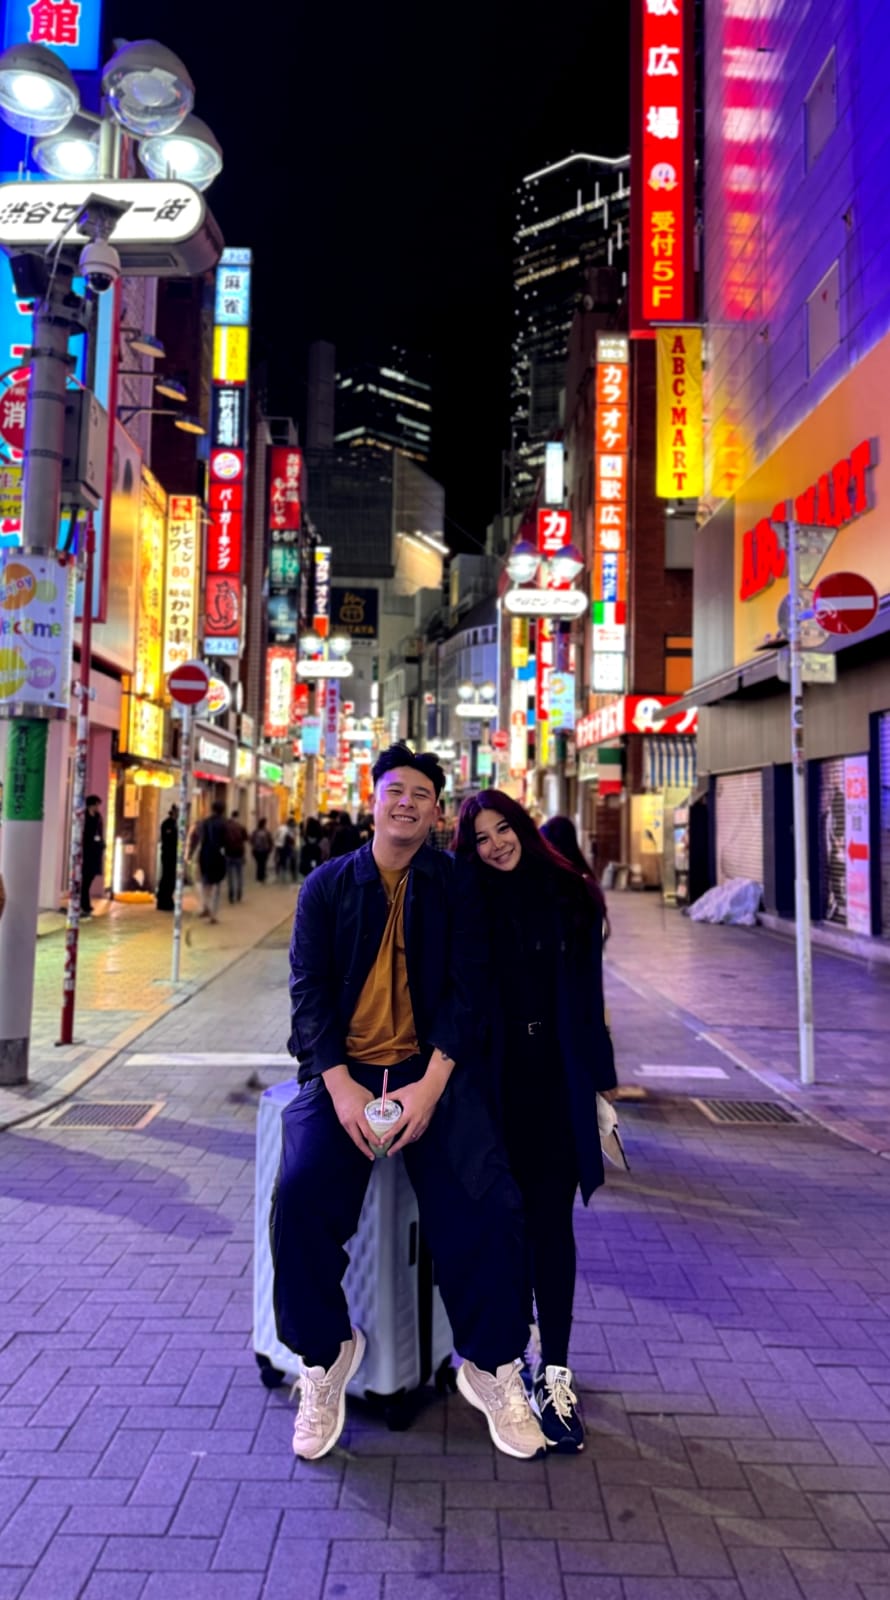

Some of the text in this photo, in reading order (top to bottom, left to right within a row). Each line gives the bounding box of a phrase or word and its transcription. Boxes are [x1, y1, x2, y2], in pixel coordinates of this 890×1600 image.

[602, 365, 622, 448] カラオケ
[600, 480, 622, 551] 歌広場
